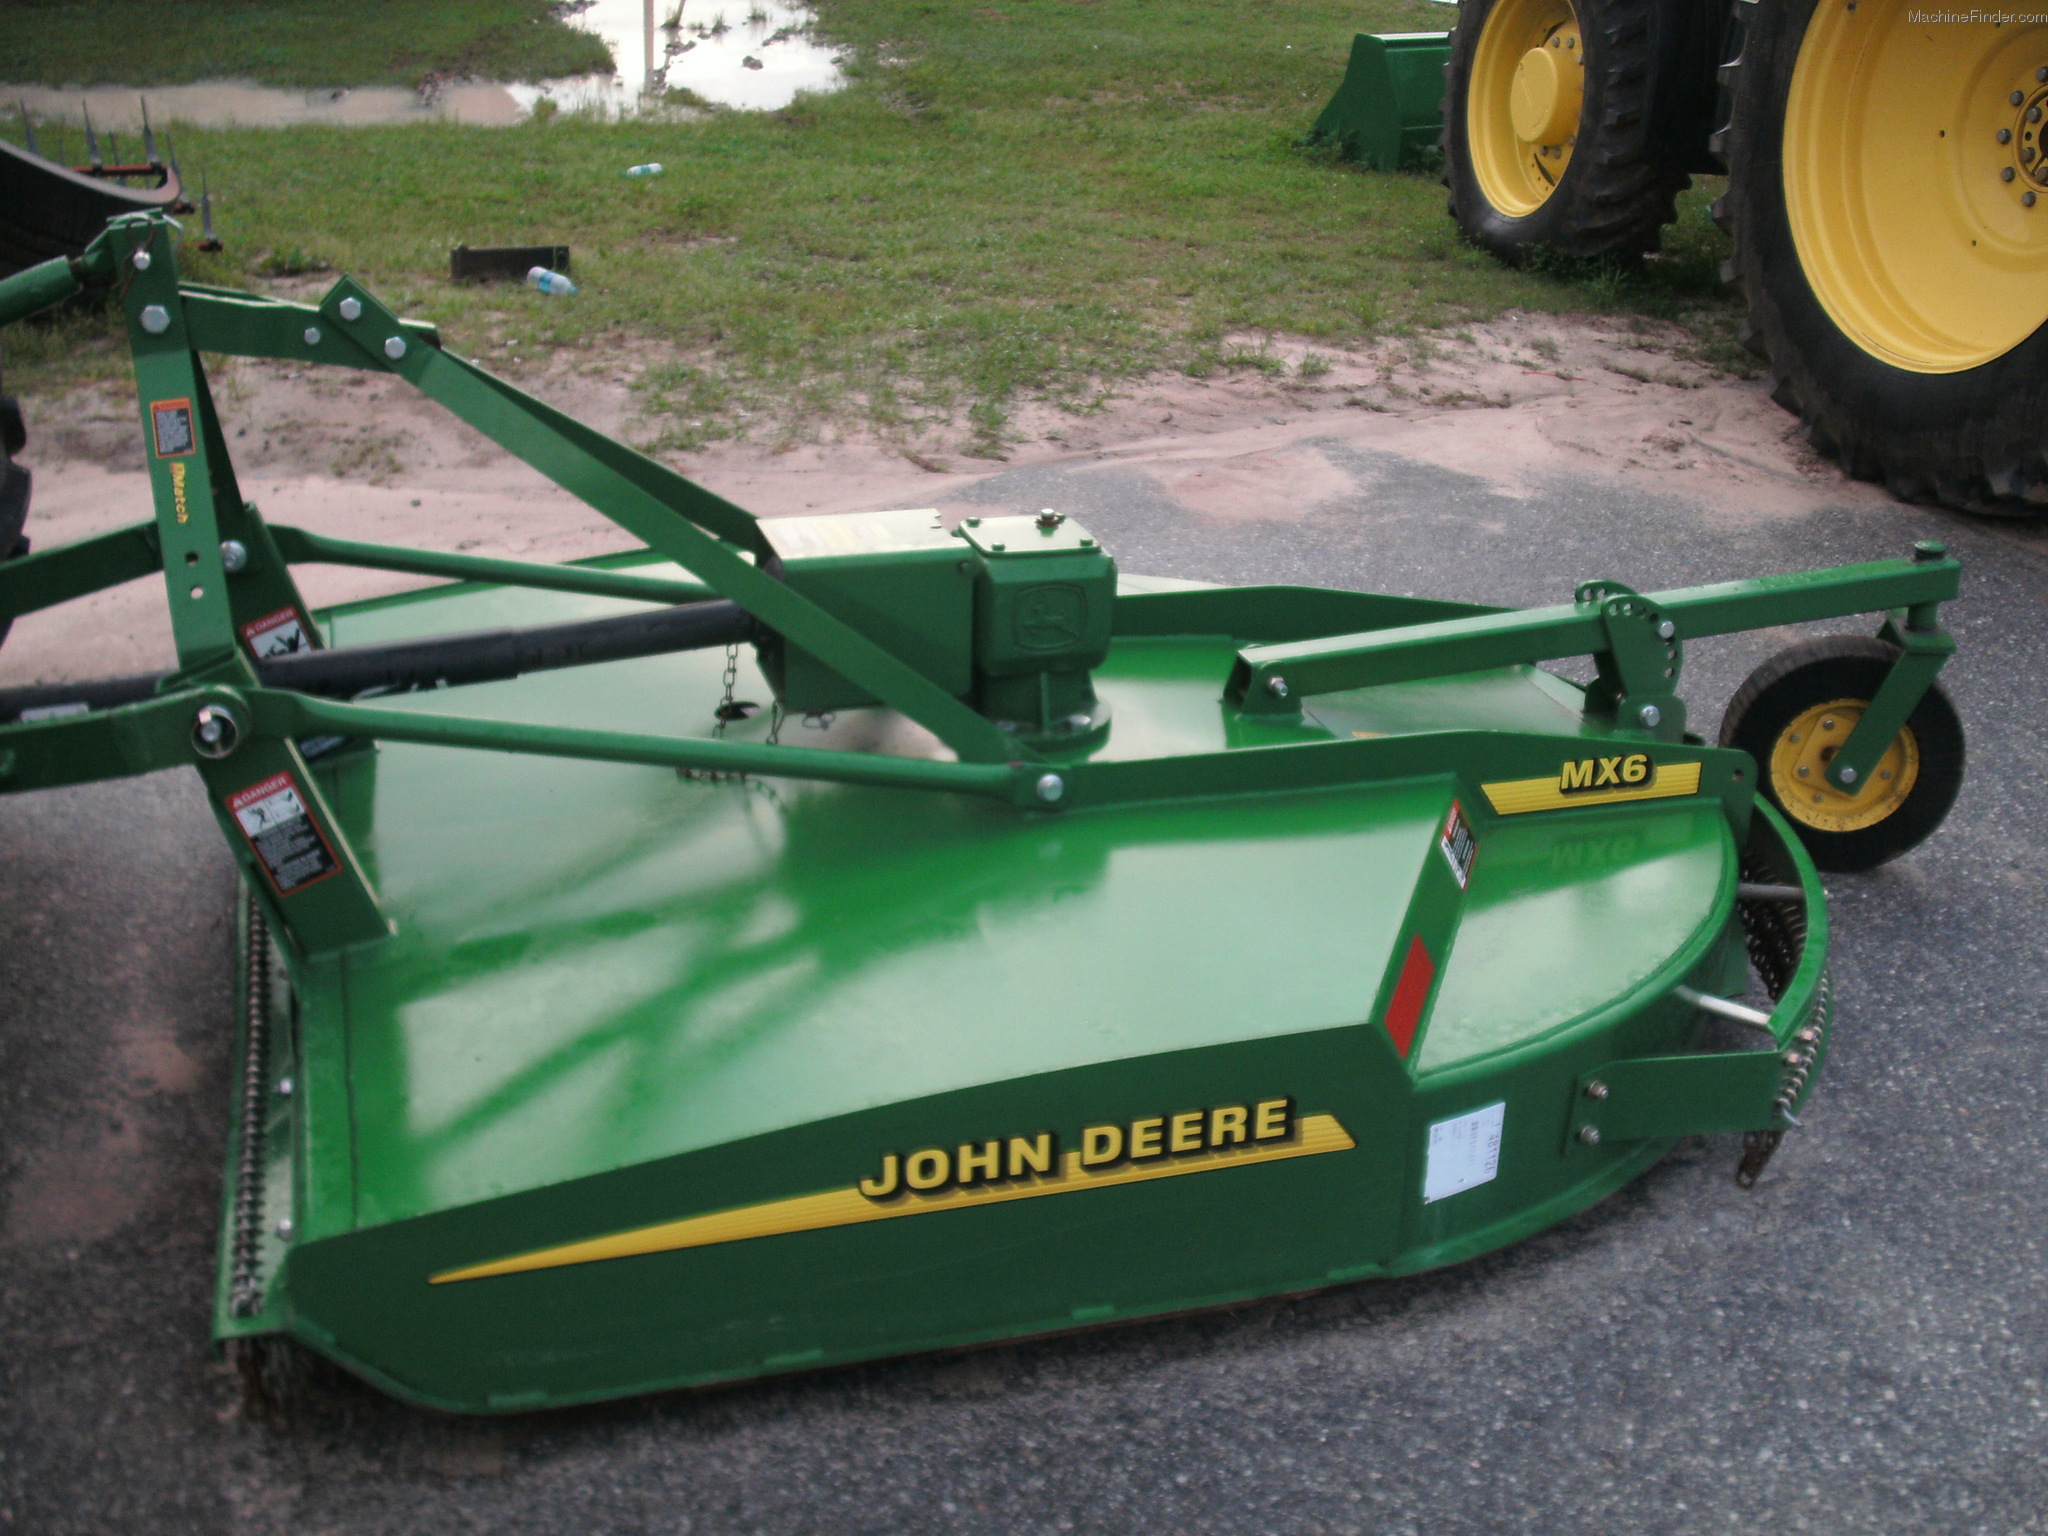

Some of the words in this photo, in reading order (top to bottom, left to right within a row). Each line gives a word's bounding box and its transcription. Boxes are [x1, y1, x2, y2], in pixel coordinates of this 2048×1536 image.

[1560, 753, 1650, 791] MX6
[858, 1133, 1053, 1199] JOHN
[1081, 1098, 1289, 1167] DEERE
